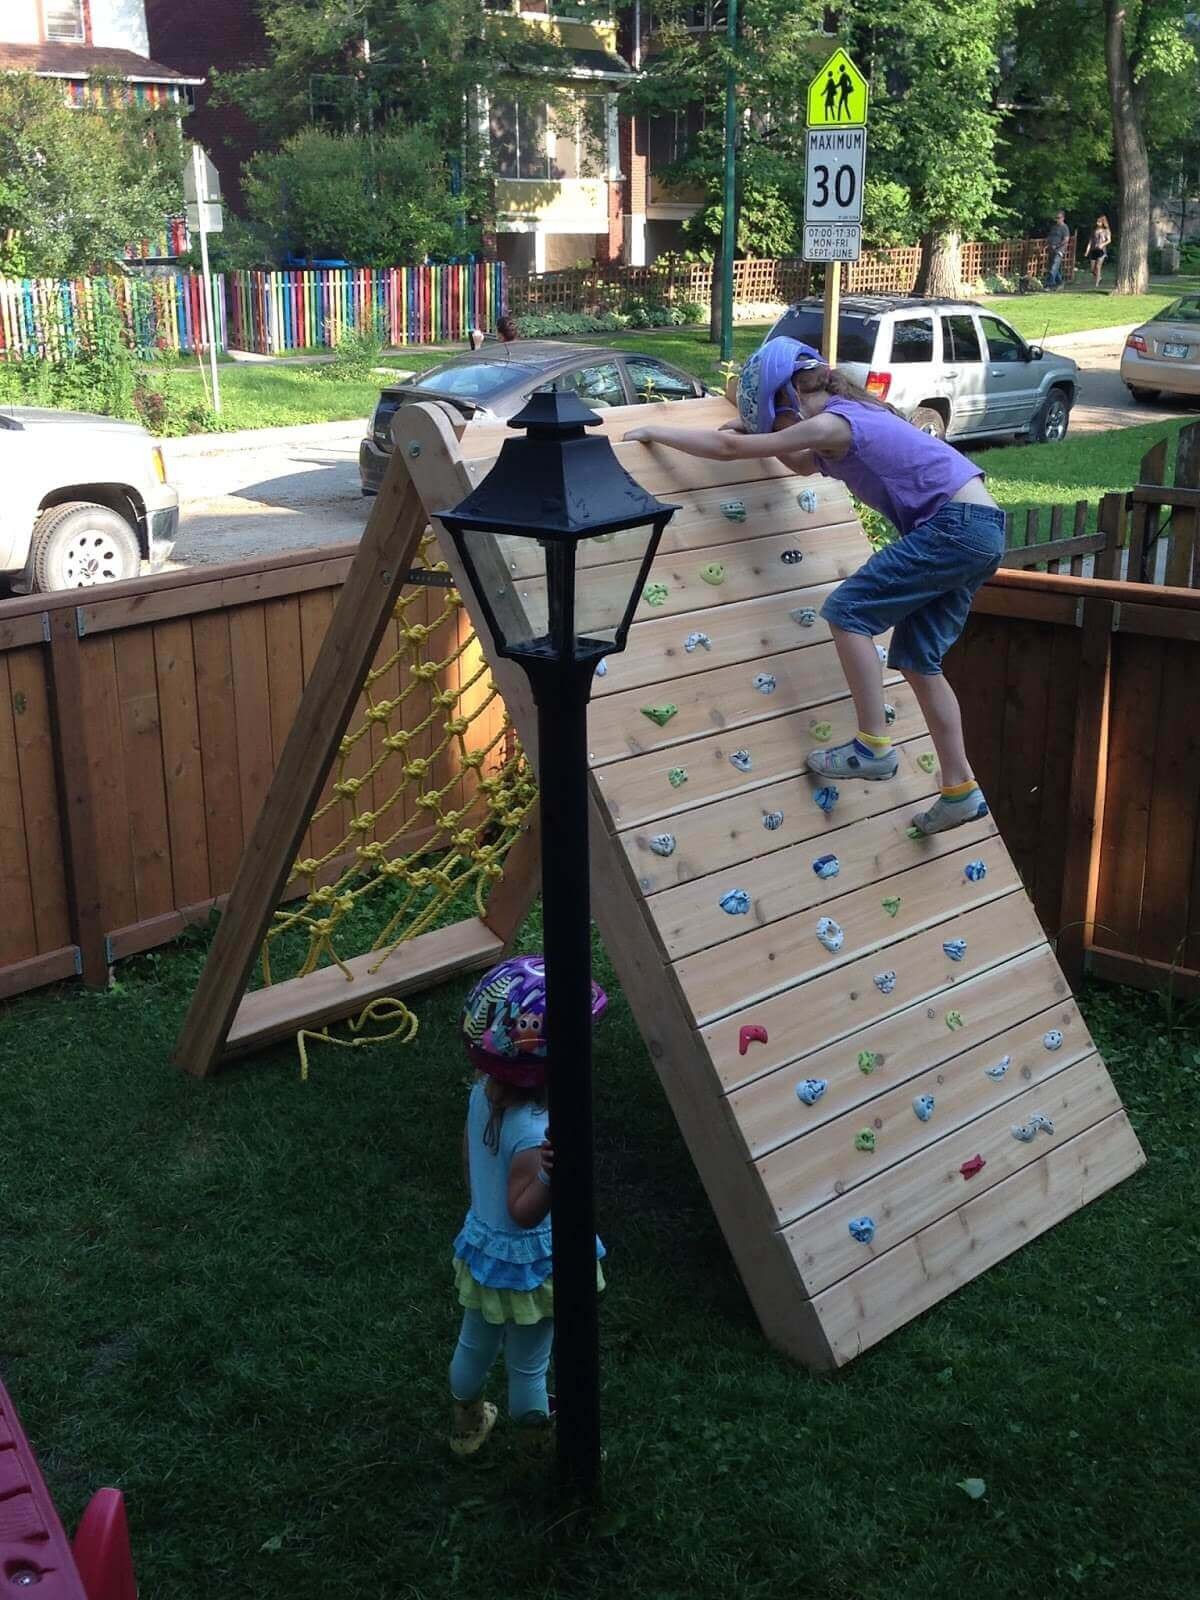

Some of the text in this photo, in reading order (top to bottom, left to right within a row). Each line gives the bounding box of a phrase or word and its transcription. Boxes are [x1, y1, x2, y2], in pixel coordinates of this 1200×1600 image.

[810, 133, 861, 150] MAXIMUM
[812, 164, 856, 208] 30
[808, 228, 857, 238] 07:00-17:30
[813, 238, 849, 248] MON-FRI
[809, 248, 853, 258] SEPT-JUNE
